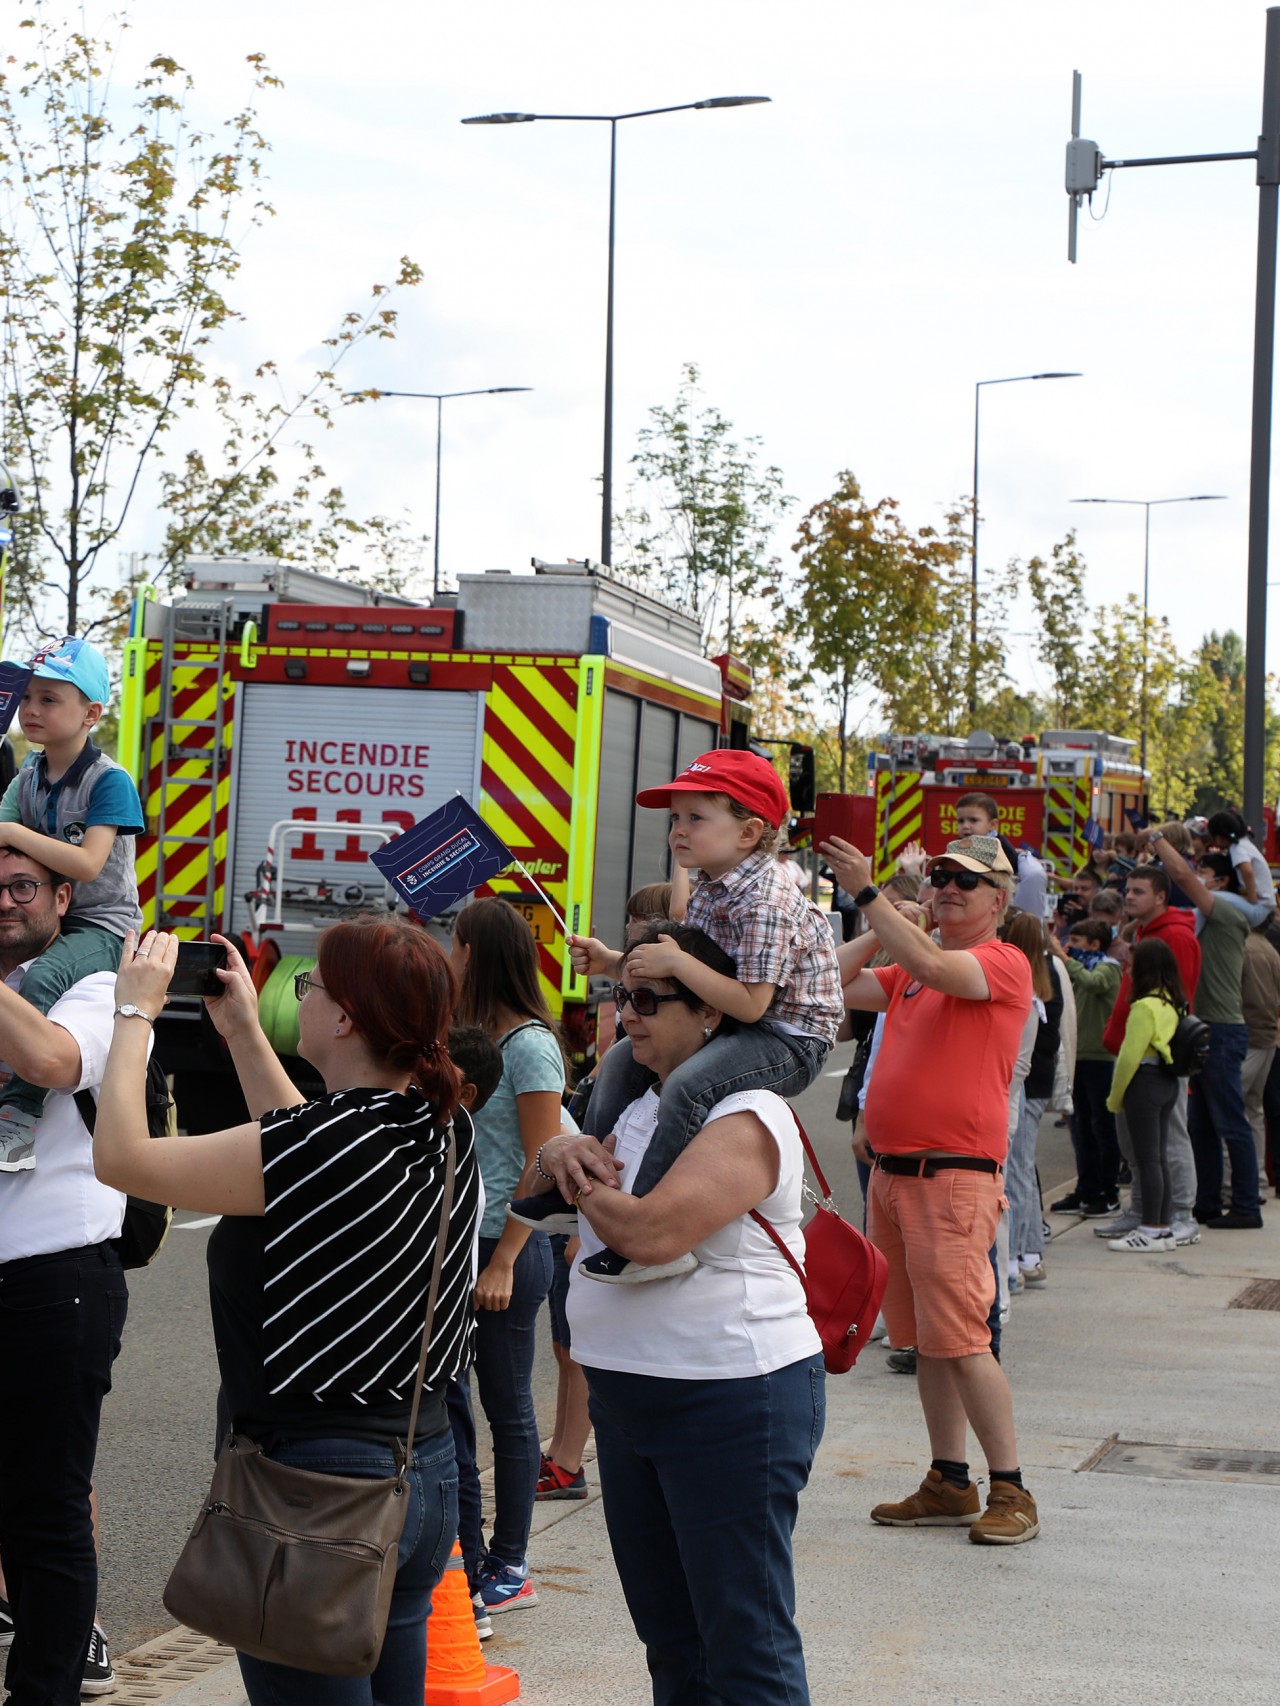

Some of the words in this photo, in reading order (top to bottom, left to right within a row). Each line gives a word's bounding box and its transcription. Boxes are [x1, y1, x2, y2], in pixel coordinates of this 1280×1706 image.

[285, 740, 430, 768] INCENDIE
[287, 769, 425, 797] SECOURS
[939, 803, 1026, 821] INDIE
[940, 821, 1023, 837] SERS
[418, 861, 435, 873] CORPS
[433, 836, 468, 862] GRAND-DUCAL
[422, 858, 447, 878] INCENDIE
[449, 841, 472, 859] SECOURS
